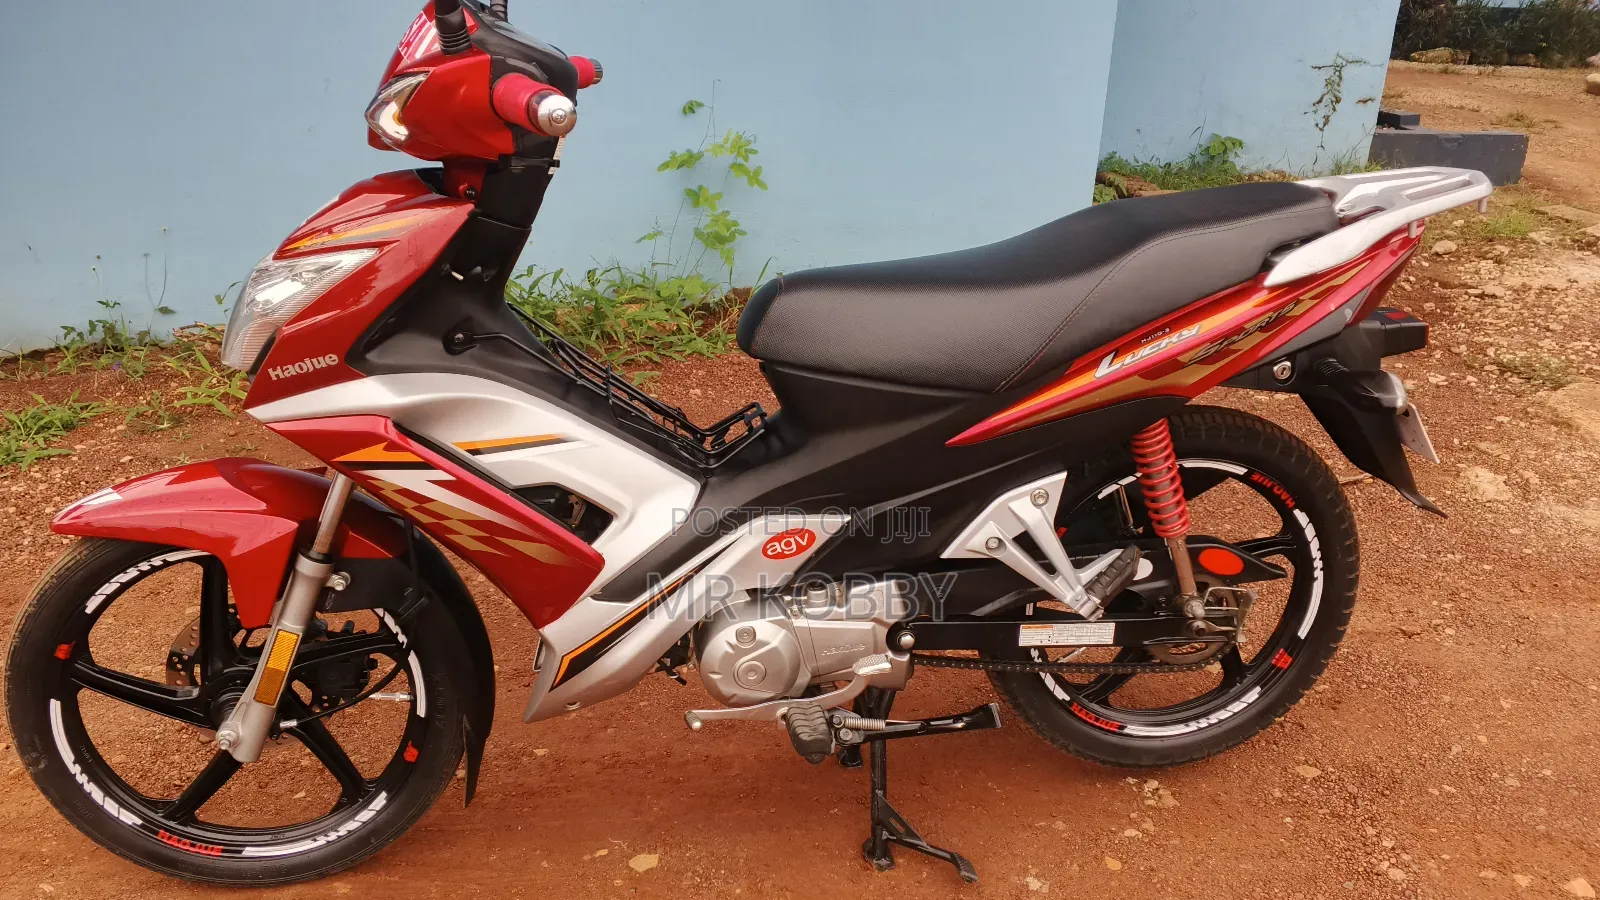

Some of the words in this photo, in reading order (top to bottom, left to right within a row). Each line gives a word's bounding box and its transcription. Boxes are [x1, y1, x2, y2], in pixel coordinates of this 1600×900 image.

[267, 354, 339, 380] Haojue
[1251, 472, 1296, 508] HAOJUE
[765, 532, 809, 555] agv
[157, 829, 224, 856] HAOJUE
